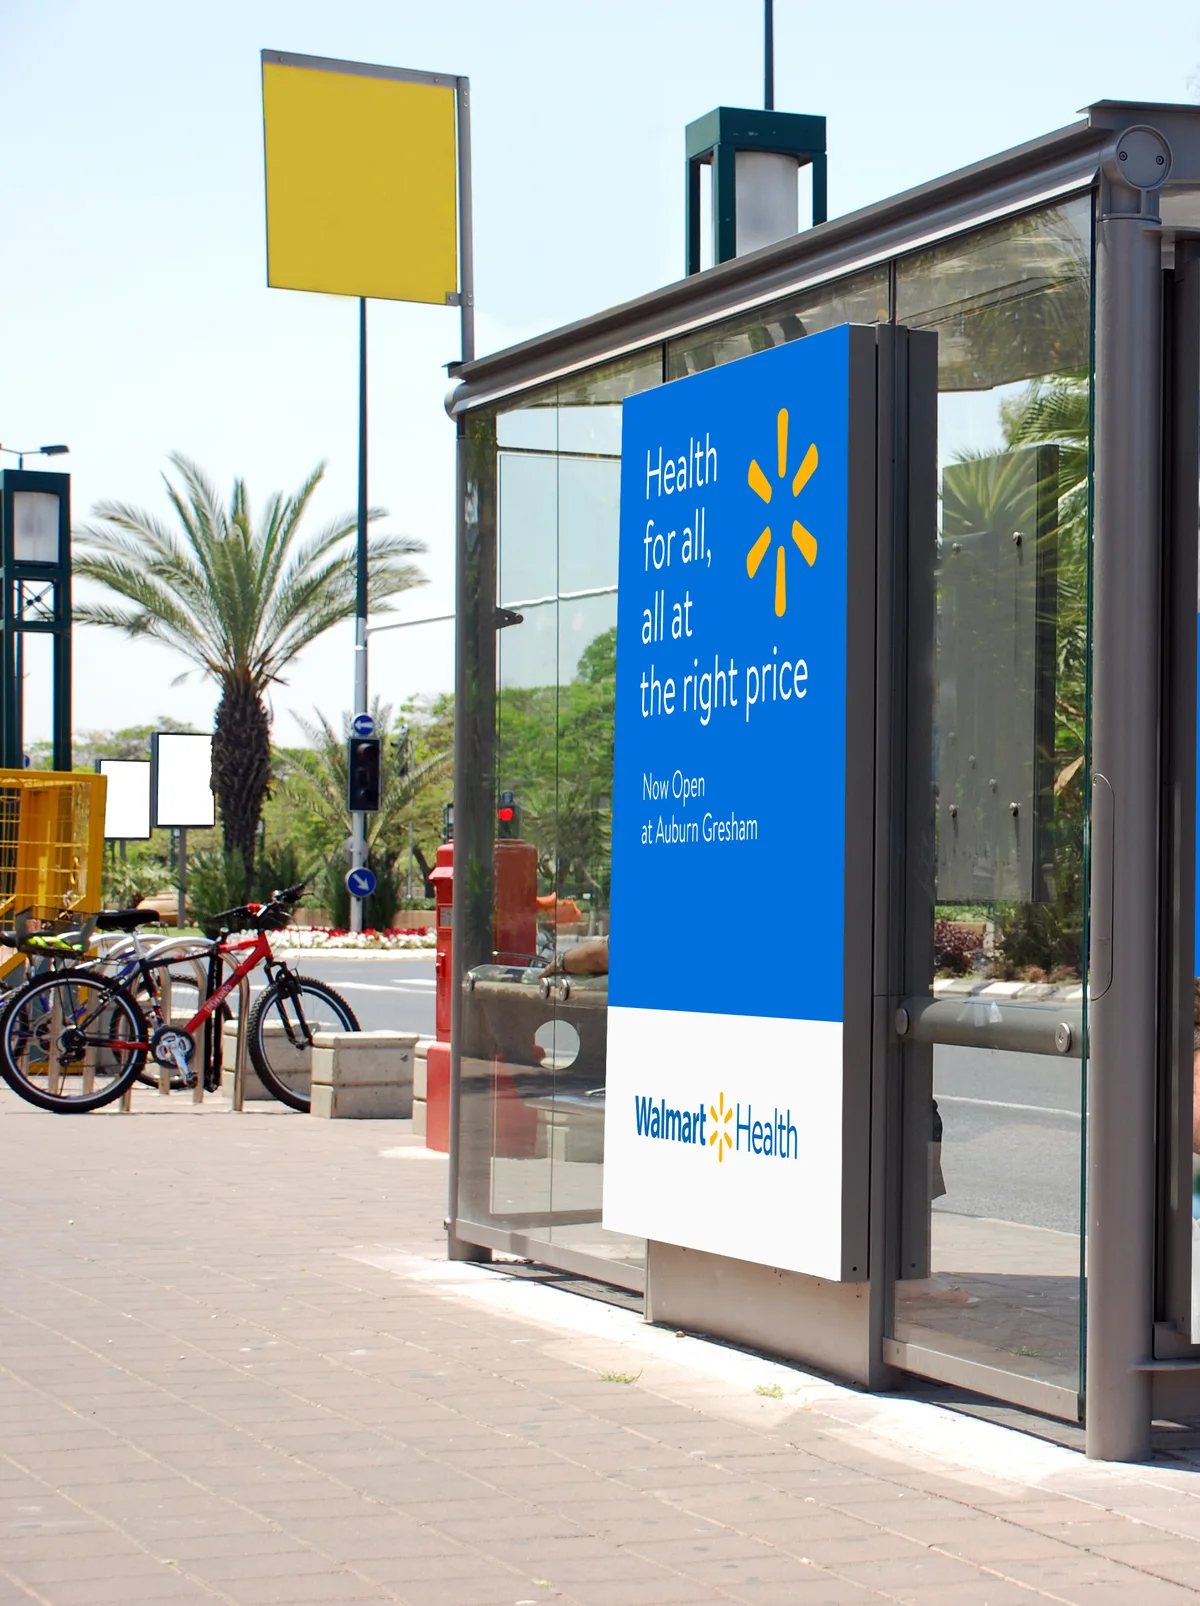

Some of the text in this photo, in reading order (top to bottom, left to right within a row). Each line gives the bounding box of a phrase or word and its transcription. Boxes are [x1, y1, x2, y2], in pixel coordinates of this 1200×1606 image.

[646, 432, 717, 500] Health
[643, 506, 712, 572] for all,
[641, 589, 693, 645] all at
[639, 645, 809, 726] the right price
[642, 769, 705, 807] Now Open
[641, 811, 758, 845] at Auburn Gresham
[634, 1095, 798, 1160] Walmart Health
